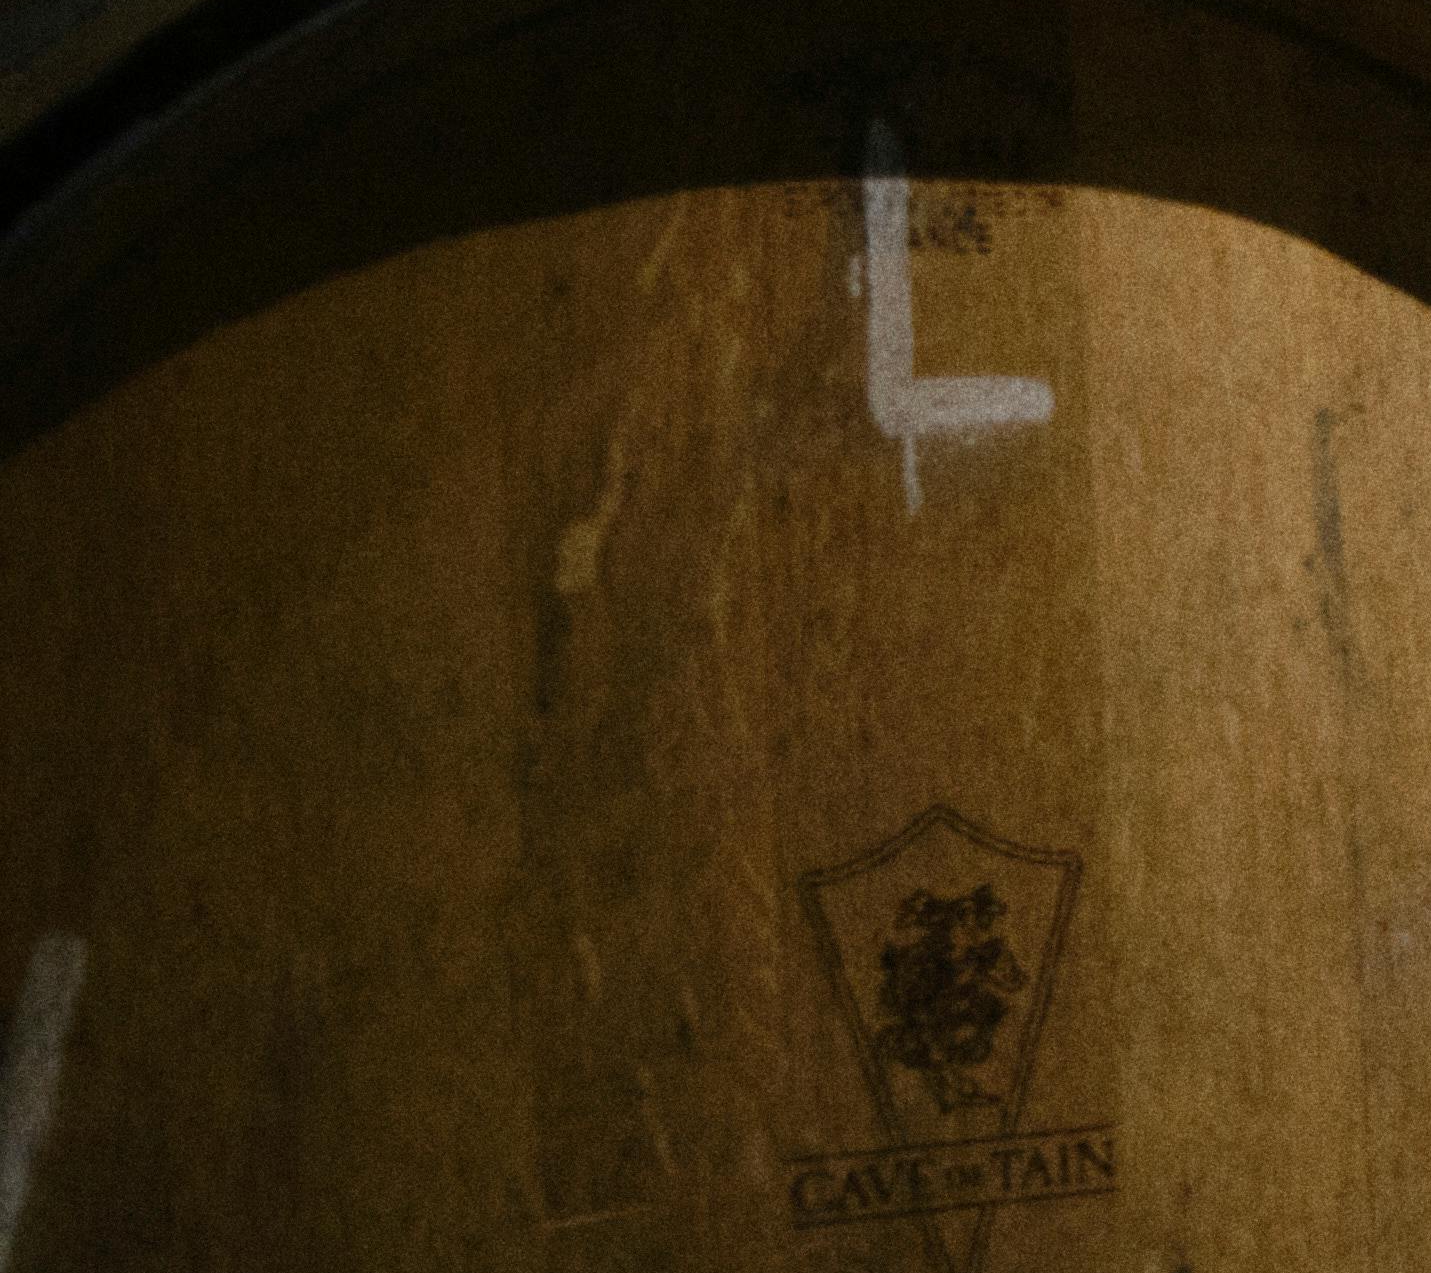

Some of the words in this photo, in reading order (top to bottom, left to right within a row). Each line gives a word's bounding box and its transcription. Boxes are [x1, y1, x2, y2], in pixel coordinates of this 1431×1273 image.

[862, 121, 1056, 440] L
[790, 1152, 930, 1214] CAVE
[993, 1138, 1117, 1192] TAIN
